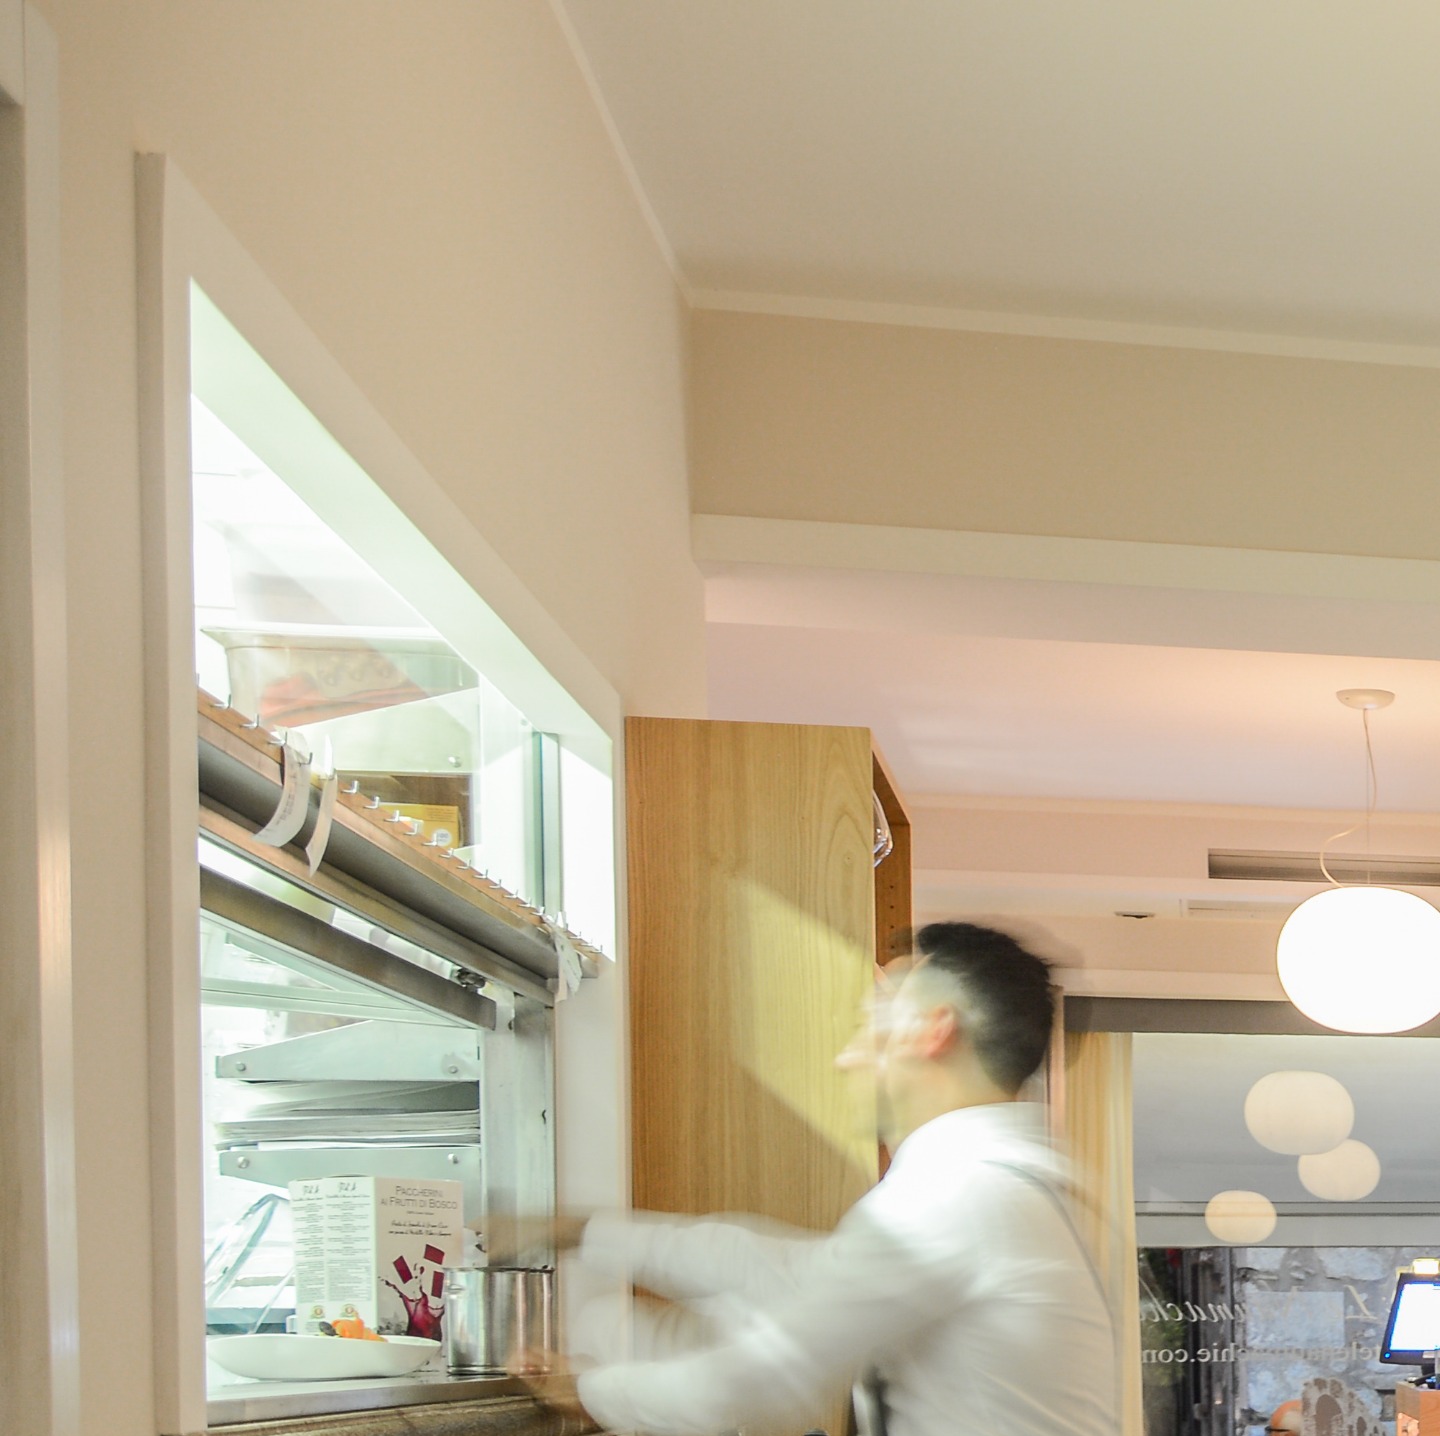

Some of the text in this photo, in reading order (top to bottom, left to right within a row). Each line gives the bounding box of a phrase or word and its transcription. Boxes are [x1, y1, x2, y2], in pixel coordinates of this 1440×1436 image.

[395, 1185, 444, 1198] PACCHERINI
[389, 1196, 417, 1207] FRUTTI
[429, 1198, 458, 1209] BOSCO
